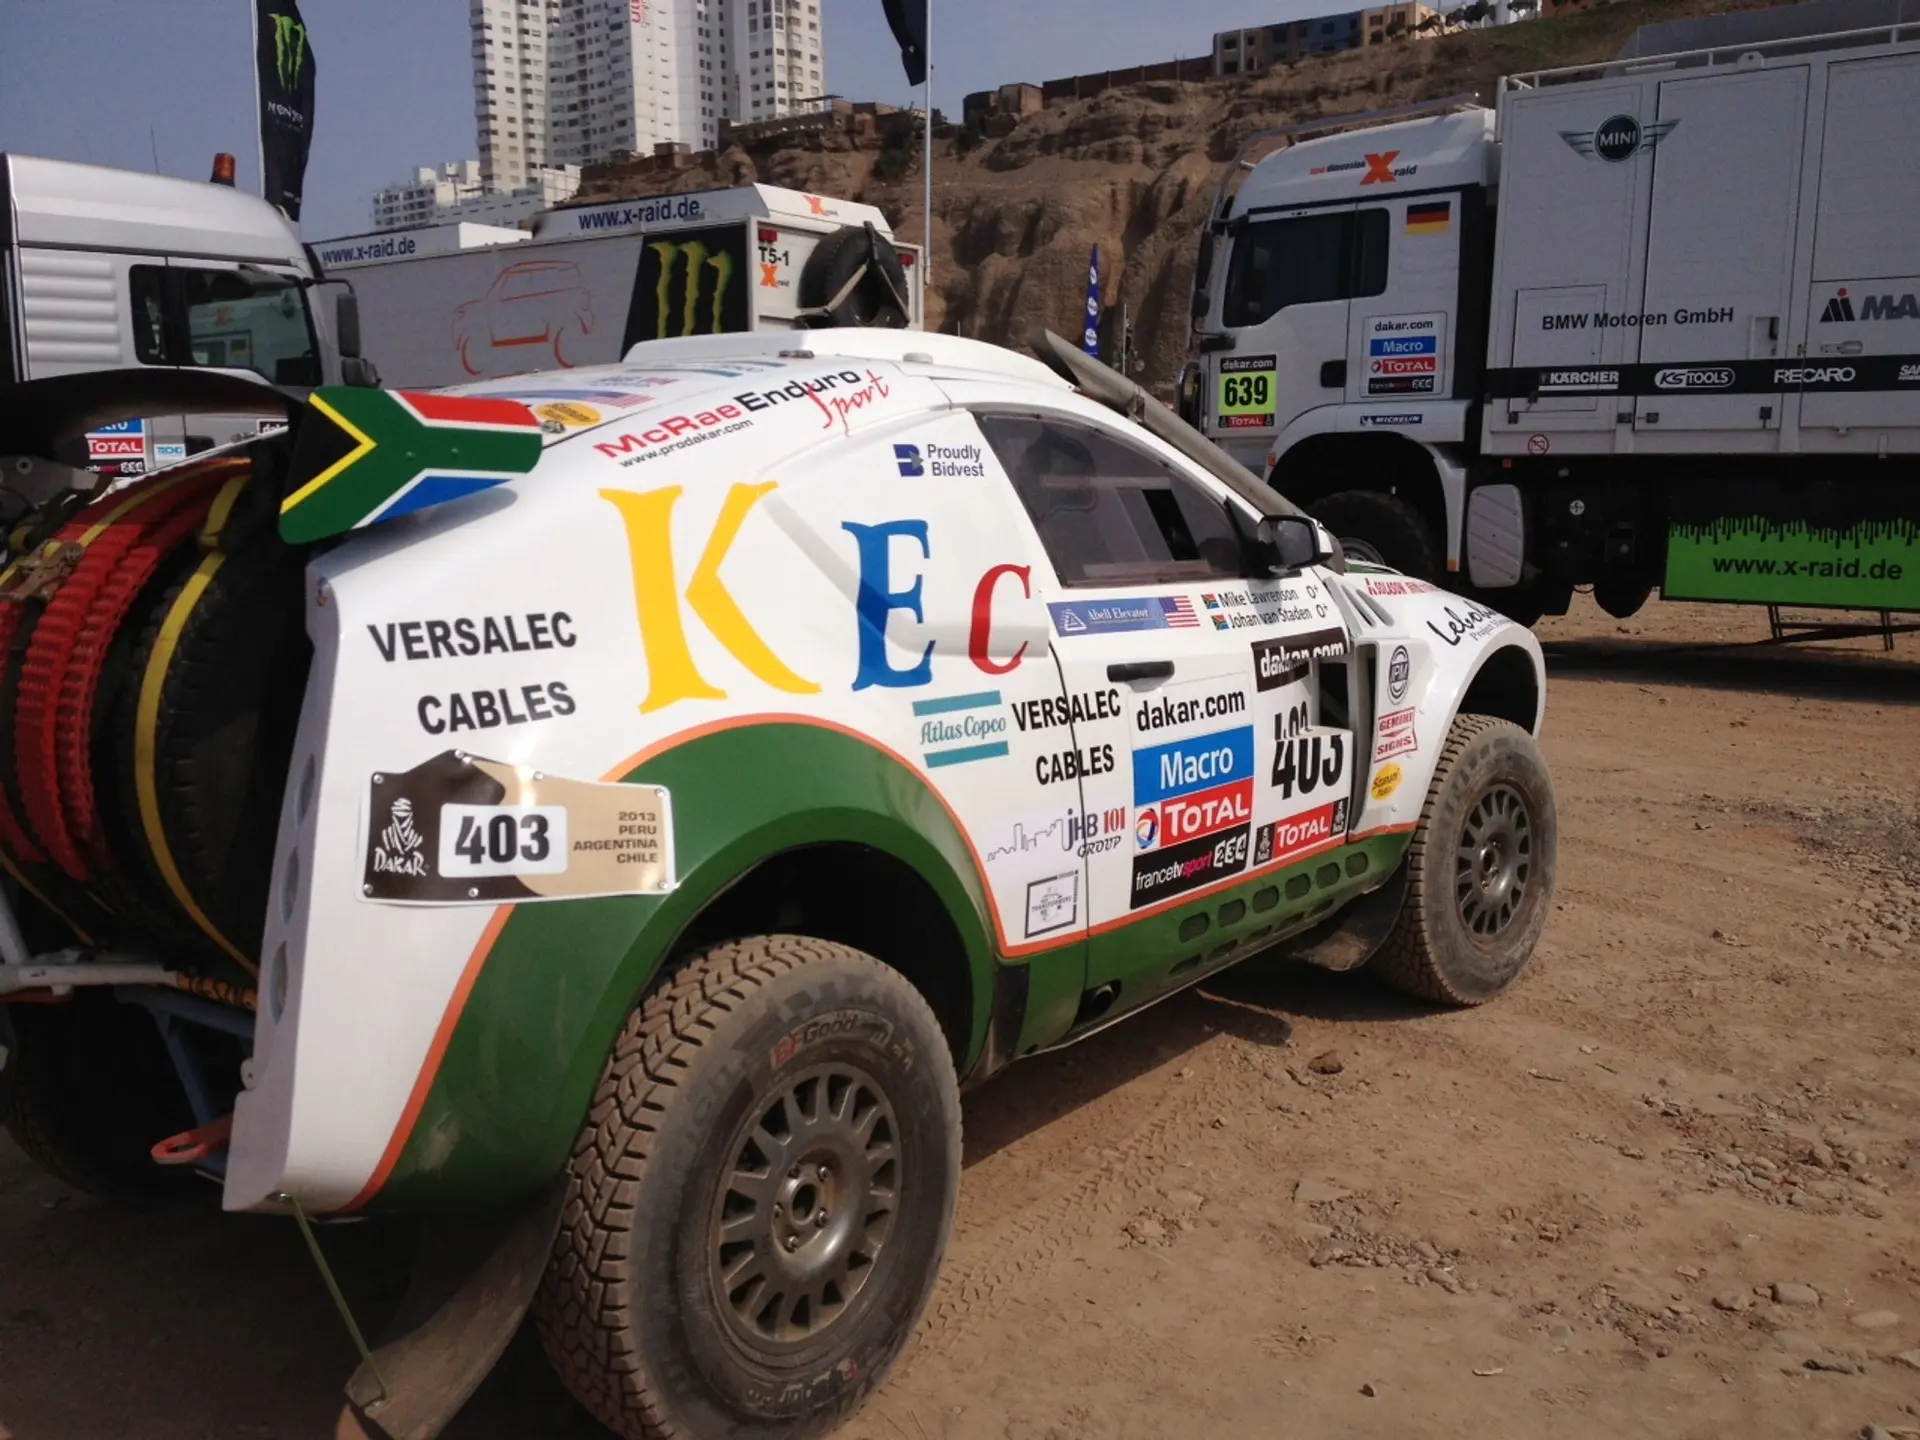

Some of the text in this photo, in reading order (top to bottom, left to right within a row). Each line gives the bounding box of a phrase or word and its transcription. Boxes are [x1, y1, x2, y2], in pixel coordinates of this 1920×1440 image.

[1600, 131, 1636, 147] MINI
[578, 199, 700, 230] www.x-raid.de
[321, 236, 416, 265] www.x-raid.de
[758, 246, 790, 267] T5-1
[1375, 320, 1434, 332] dakar.com
[1542, 308, 1734, 330] BMW Motoren GmbH
[1383, 341, 1423, 352] Macro
[1222, 359, 1273, 370] dakar.com
[1386, 361, 1433, 372] TOTAL
[1774, 366, 1856, 383] RECARO
[1224, 375, 1268, 407] 639
[1230, 416, 1263, 426] TOTAL
[620, 419, 753, 469] www.prodakar.com
[927, 444, 981, 462] Proudly
[932, 461, 985, 476] Bidvest
[1713, 557, 1902, 579] www.x-raid.de
[1218, 591, 1247, 608] Mike
[1228, 611, 1260, 629] Johan
[1260, 612, 1280, 625] van
[1277, 606, 1313, 622] Staden
[367, 611, 577, 662] VERSALEC
[417, 681, 577, 735] CABLES
[1012, 689, 1121, 731] VERSALEC
[1136, 690, 1245, 731] dakar.com
[1379, 711, 1412, 732] GEMINI
[1377, 736, 1412, 755] SIGNS
[1036, 744, 1115, 785] CABLES
[1160, 747, 1233, 790] Macro
[618, 811, 656, 822] 2013
[1103, 807, 1126, 834] 101
[1165, 792, 1249, 838] TOTAL
[455, 813, 550, 864] 403
[618, 825, 657, 835] PERU
[1277, 815, 1329, 848] TOTAL
[573, 839, 658, 851] ARGENTINA
[1077, 835, 1121, 858] GROUP
[374, 846, 427, 876] DAKAR
[616, 852, 658, 864] CHILE
